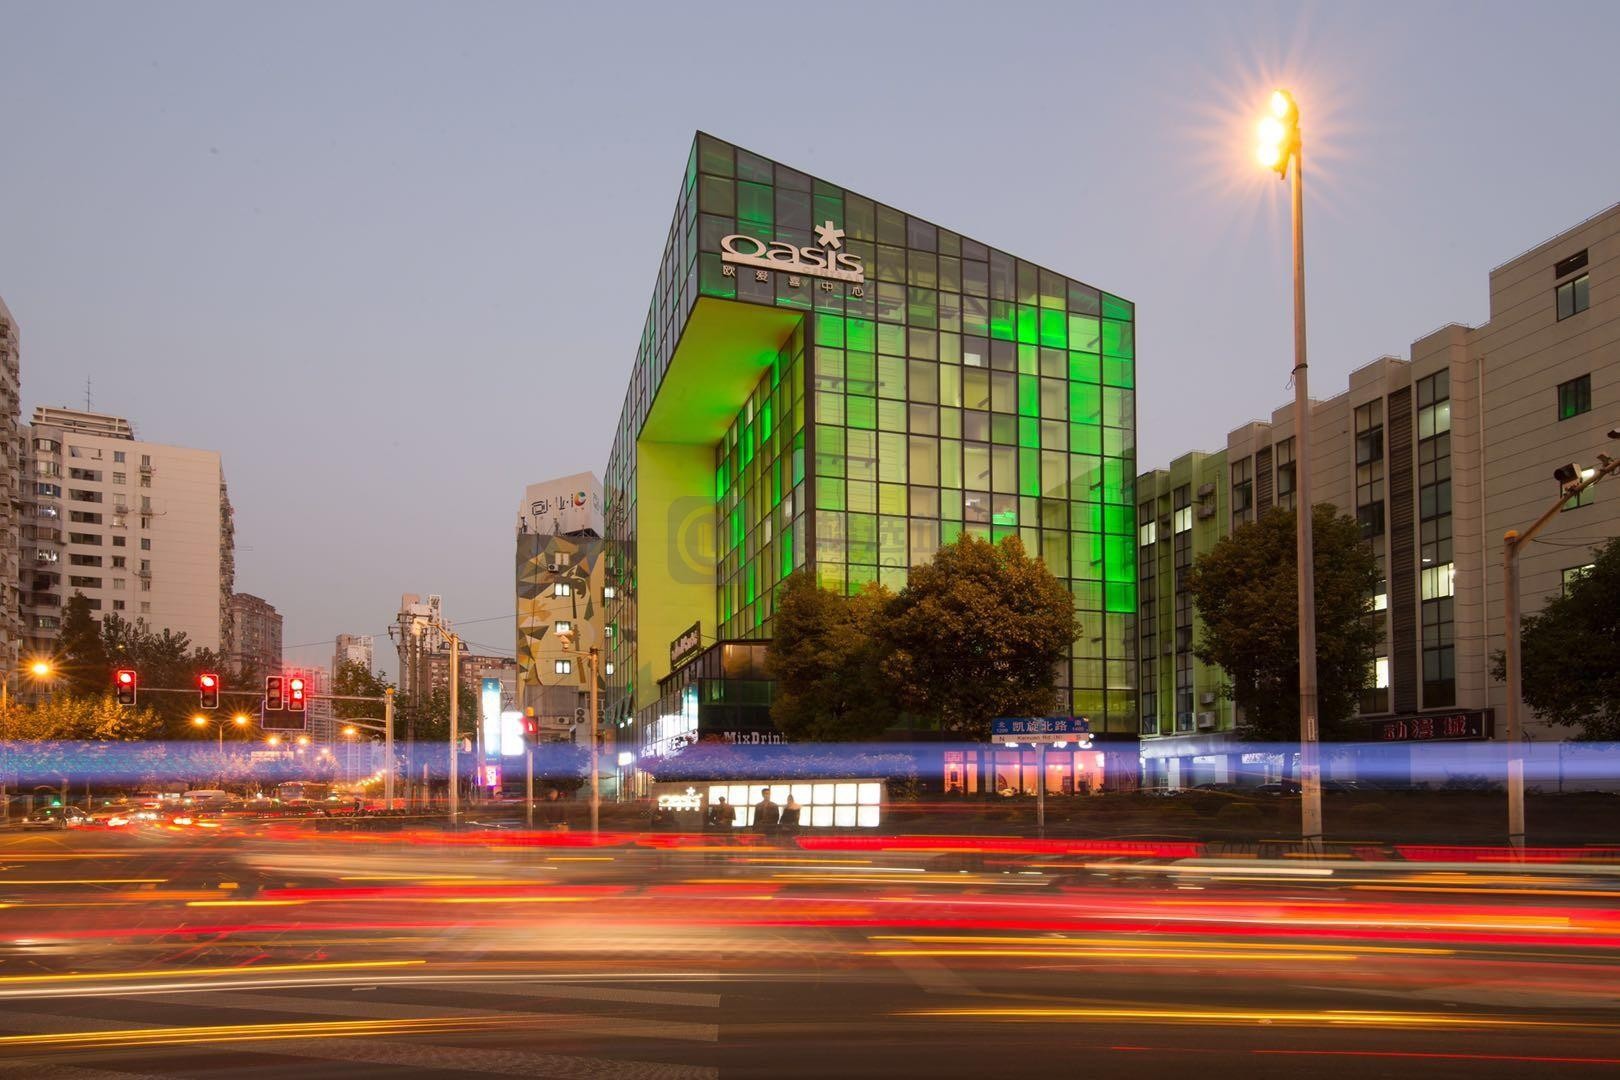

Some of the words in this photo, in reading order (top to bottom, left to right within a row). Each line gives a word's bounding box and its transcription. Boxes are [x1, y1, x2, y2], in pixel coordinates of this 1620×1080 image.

[721, 222, 864, 276] Oasis
[1012, 720, 1067, 732] 凯旋北路
